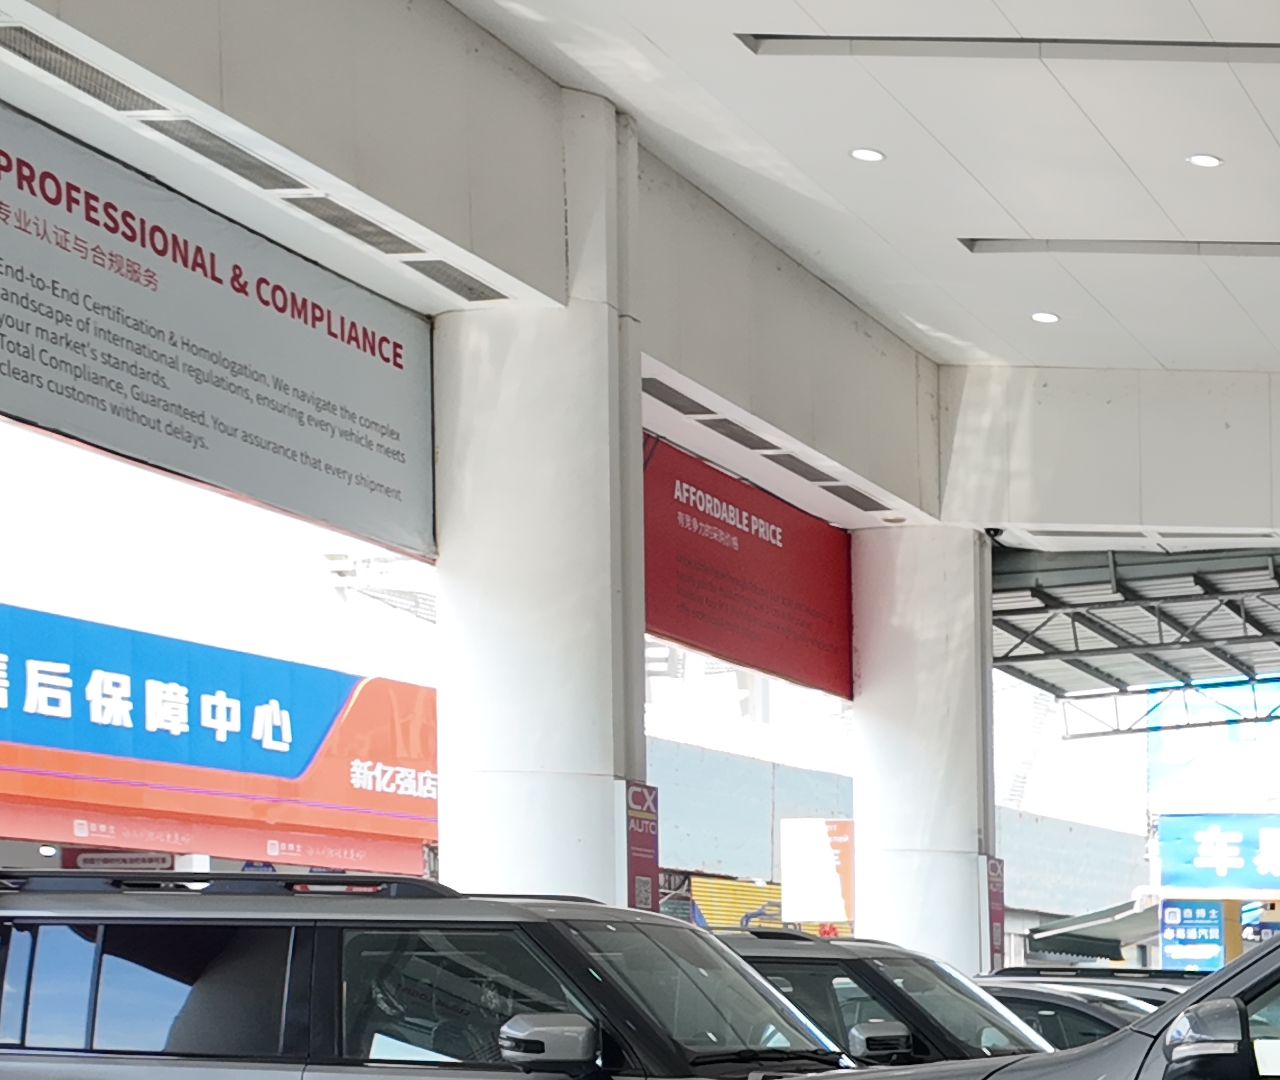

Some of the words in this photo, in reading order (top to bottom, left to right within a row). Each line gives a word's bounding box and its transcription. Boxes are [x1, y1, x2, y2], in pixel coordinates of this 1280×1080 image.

[0, 149, 223, 285] PROFESSIONAL
[230, 264, 249, 297] &
[256, 277, 404, 370] COMPLIANCE
[36, 324, 98, 362] market's
[101, 351, 171, 391] standards.
[76, 317, 90, 334] of
[94, 320, 180, 372] international
[182, 361, 254, 404] regulations,
[256, 392, 305, 427] ensuring
[307, 413, 336, 439] every
[338, 426, 374, 452] vehicle
[376, 441, 406, 465] meets
[83, 294, 166, 343] Certification
[168, 330, 178, 348] &
[181, 335, 270, 388] Homologation.
[272, 374, 290, 396] We
[292, 386, 338, 416] navigate
[340, 405, 357, 425] the
[359, 414, 401, 442] complex
[0, 360, 43, 389] clears
[47, 379, 107, 413] customs
[110, 402, 162, 434] without
[165, 421, 210, 450] delays.
[0, 332, 35, 362] Total
[39, 348, 128, 400] Compliance,
[130, 385, 210, 429] Guaranteed.
[211, 414, 239, 438] Your
[241, 429, 298, 462] assurance
[300, 451, 322, 472] that
[324, 461, 353, 487] every
[674, 479, 749, 533] AFFORDABLE
[751, 515, 783, 549] PRICE
[350, 758, 437, 801] 新亿强店
[628, 786, 657, 812] CX
[629, 819, 657, 835] AUTO
